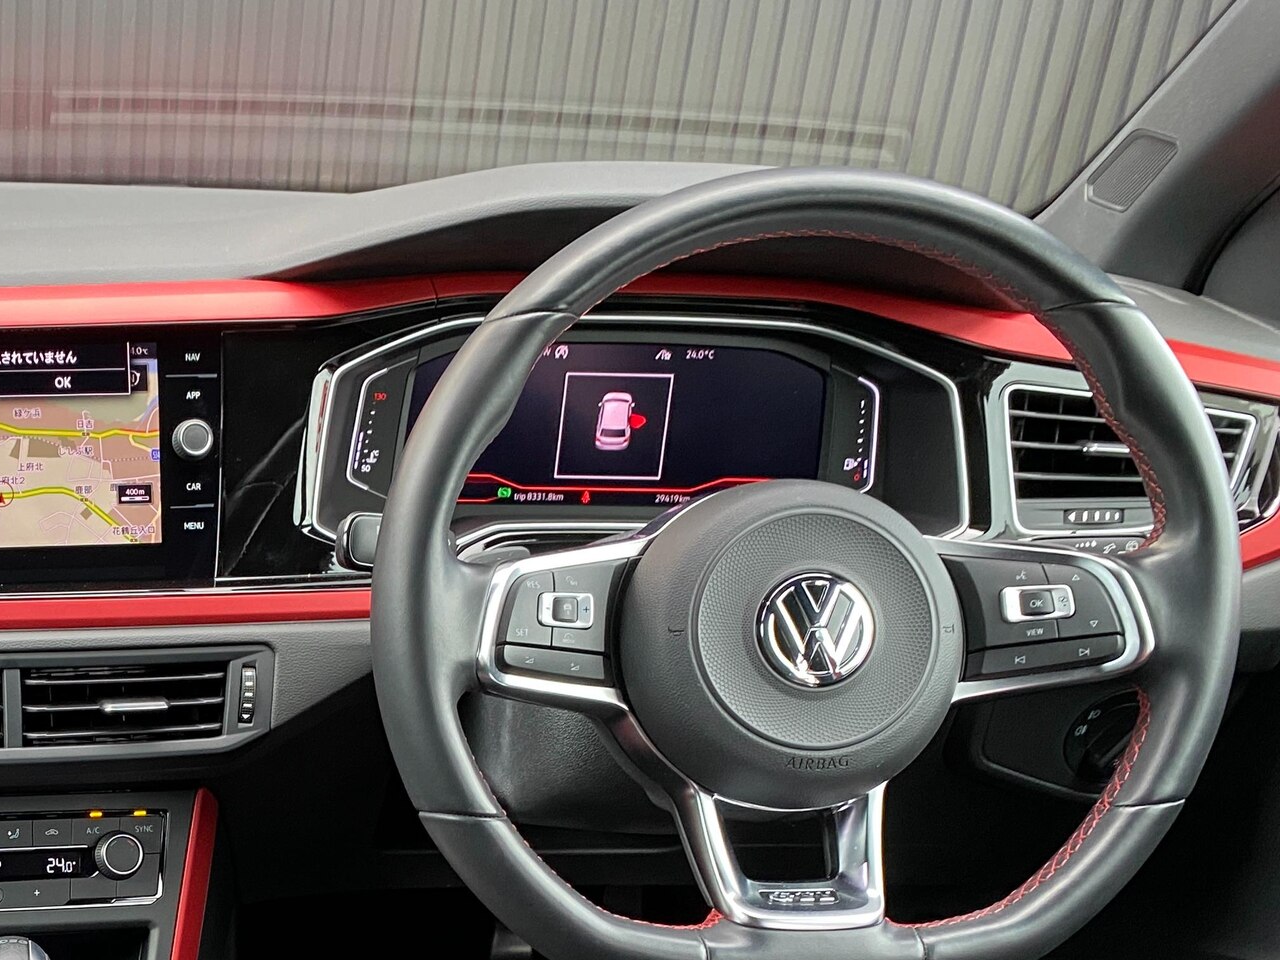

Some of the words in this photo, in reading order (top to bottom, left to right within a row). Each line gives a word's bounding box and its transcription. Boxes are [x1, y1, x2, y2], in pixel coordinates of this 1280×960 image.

[185, 353, 201, 361] NAV
[686, 350, 715, 360] 24.0°C
[55, 377, 72, 388] OK
[186, 391, 201, 400] APP
[186, 482, 201, 491] CAR
[514, 493, 526, 502] trip
[183, 522, 205, 530] MENU
[526, 580, 540, 589] RES
[1029, 599, 1044, 608] OK
[515, 627, 529, 636] SET
[785, 755, 849, 769] AIRBAG
[86, 826, 100, 835] A/C
[134, 825, 154, 833] SYNC
